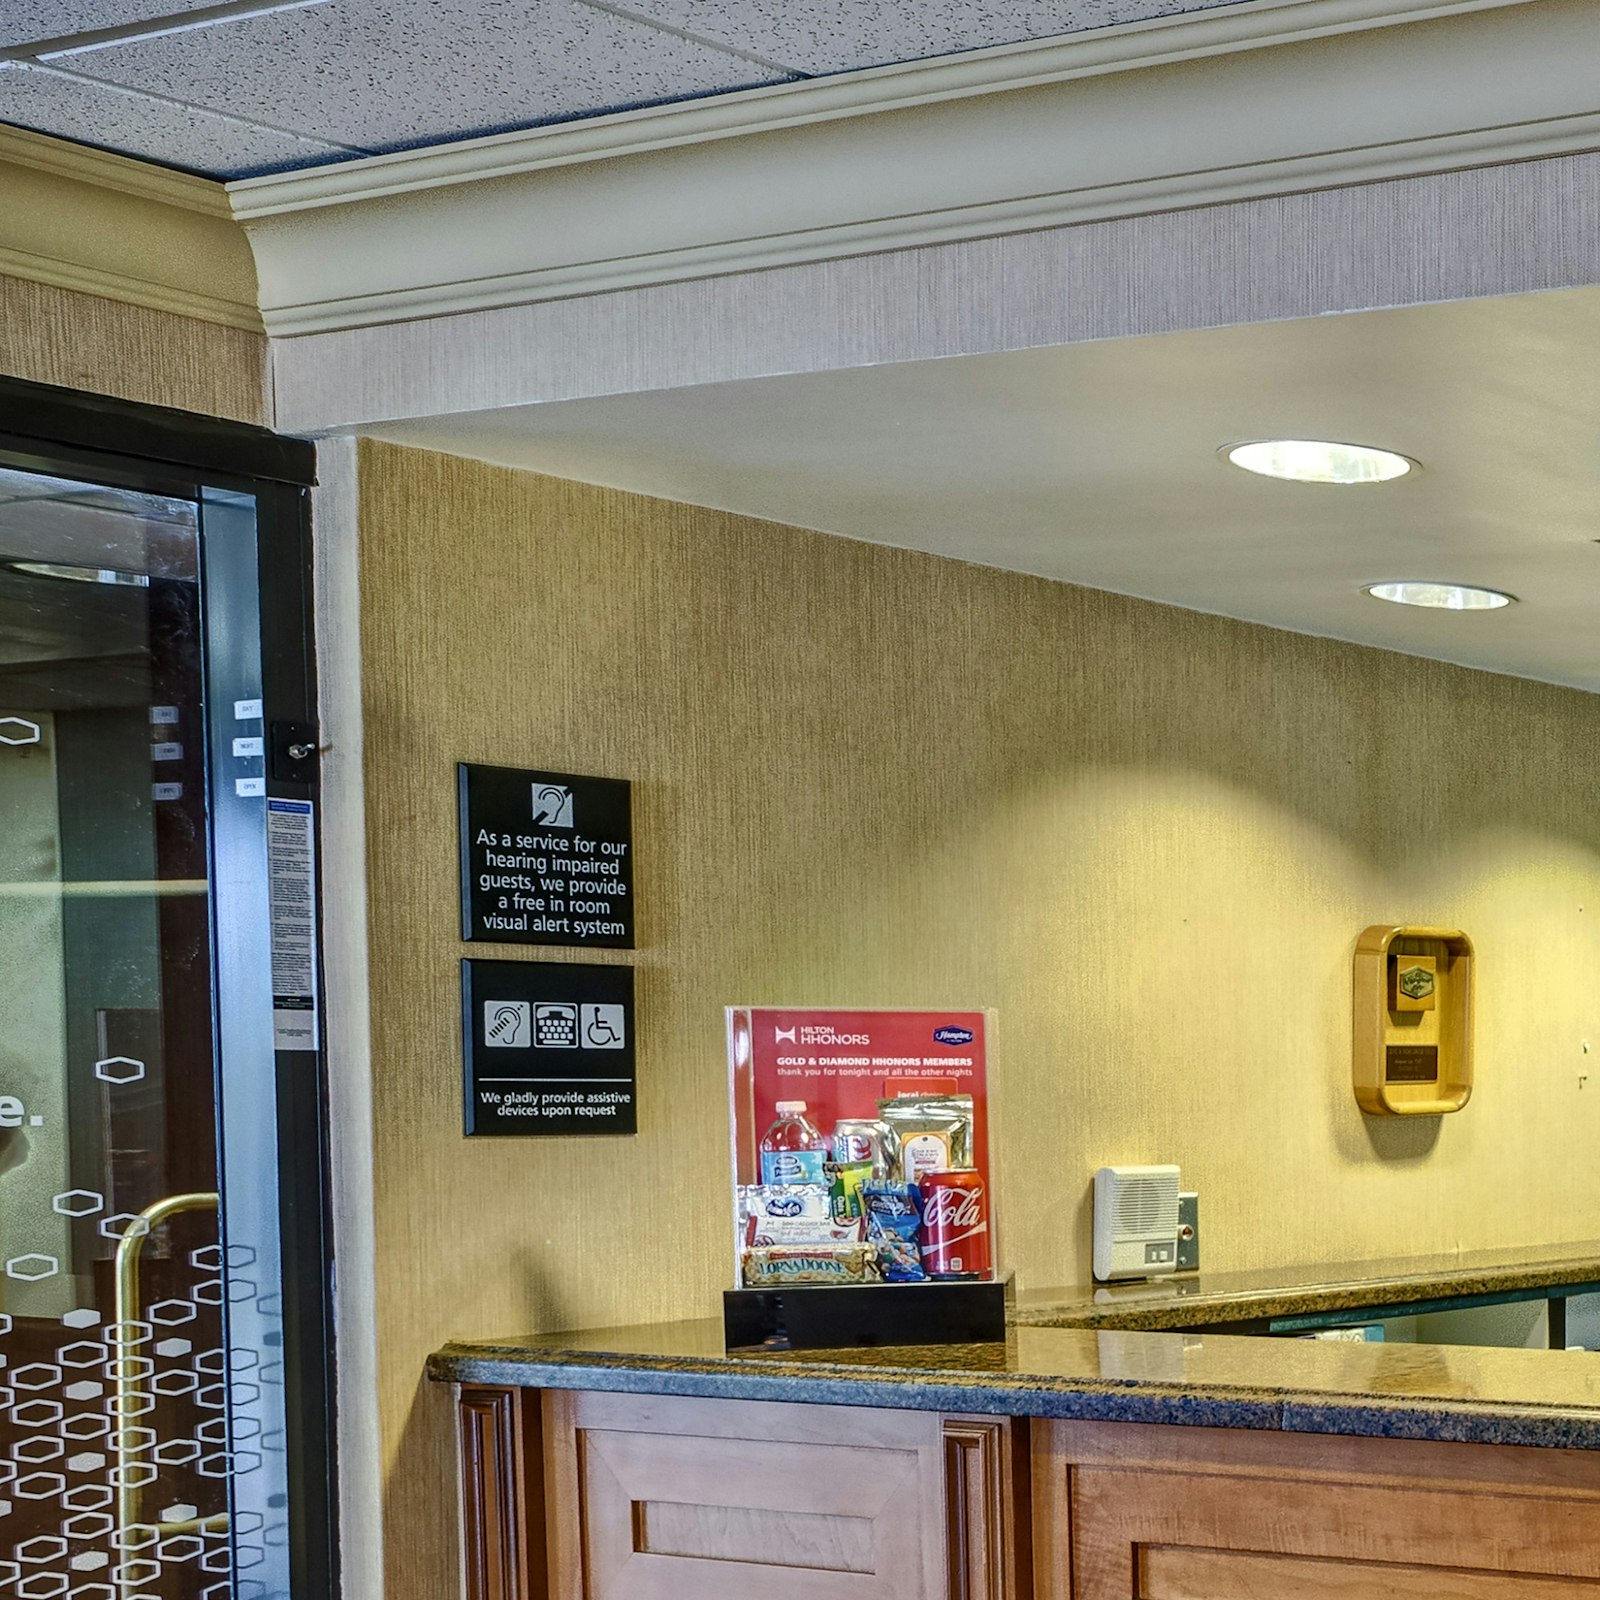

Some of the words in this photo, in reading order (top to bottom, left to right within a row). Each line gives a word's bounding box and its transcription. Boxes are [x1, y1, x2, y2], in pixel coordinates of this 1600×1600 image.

[476, 829, 496, 846] As
[502, 834, 511, 846] a
[516, 834, 569, 851] service
[574, 836, 596, 853] for
[601, 841, 627, 856] our
[486, 851, 546, 874] hearing
[552, 856, 619, 876] impaired
[480, 874, 535, 892] guests,
[540, 878, 563, 890] we
[570, 879, 626, 896] provide
[498, 896, 507, 909] a
[513, 893, 544, 910] free
[551, 896, 563, 912] in
[570, 901, 610, 914] room
[483, 913, 527, 930] visual
[533, 915, 569, 933] alert
[574, 920, 625, 937] system
[801, 1026, 834, 1034] HILTON
[936, 1030, 973, 1041] Hampton
[801, 1034, 870, 1045] HHONORS
[777, 1058, 805, 1066] GOLD
[809, 1058, 816, 1066] &
[819, 1058, 869, 1066] DIAMOND
[872, 1058, 920, 1066] HHONORS
[923, 1058, 972, 1066] MEMBERS
[777, 1068, 802, 1076] thank
[824, 1068, 835, 1076] for
[839, 1069, 870, 1077] tonight
[892, 1068, 902, 1076] all
[947, 1069, 973, 1077] nights
[481, 1093, 501, 1103] We
[504, 1092, 539, 1106] gladly
[542, 1092, 584, 1106] provide
[587, 1092, 630, 1103] assistive
[497, 1105, 538, 1116] devices
[542, 1106, 571, 1118] upon
[575, 1107, 616, 1118] request
[922, 1187, 983, 1227] Cola
